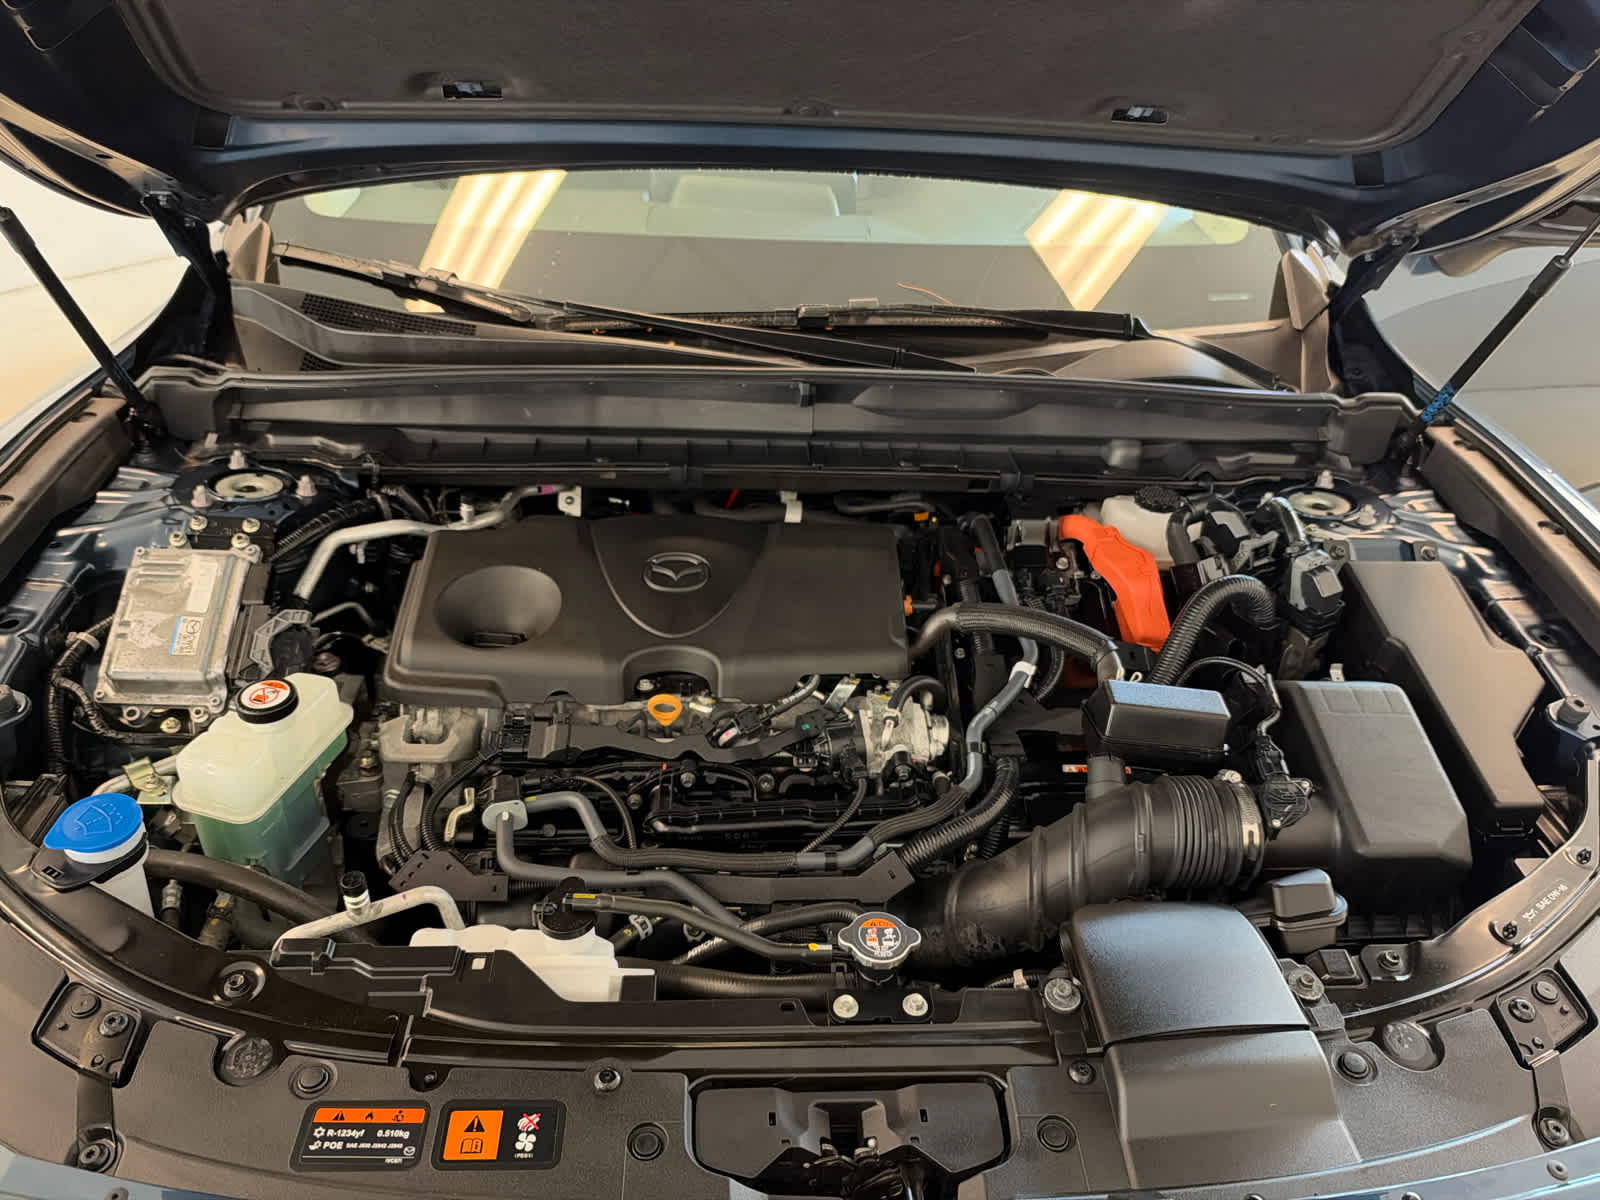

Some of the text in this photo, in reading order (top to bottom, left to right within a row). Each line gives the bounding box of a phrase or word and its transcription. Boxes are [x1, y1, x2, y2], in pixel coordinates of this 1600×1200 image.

[326, 1128, 410, 1139] R-1234yf 0.510kg
[322, 1141, 344, 1150] POE
